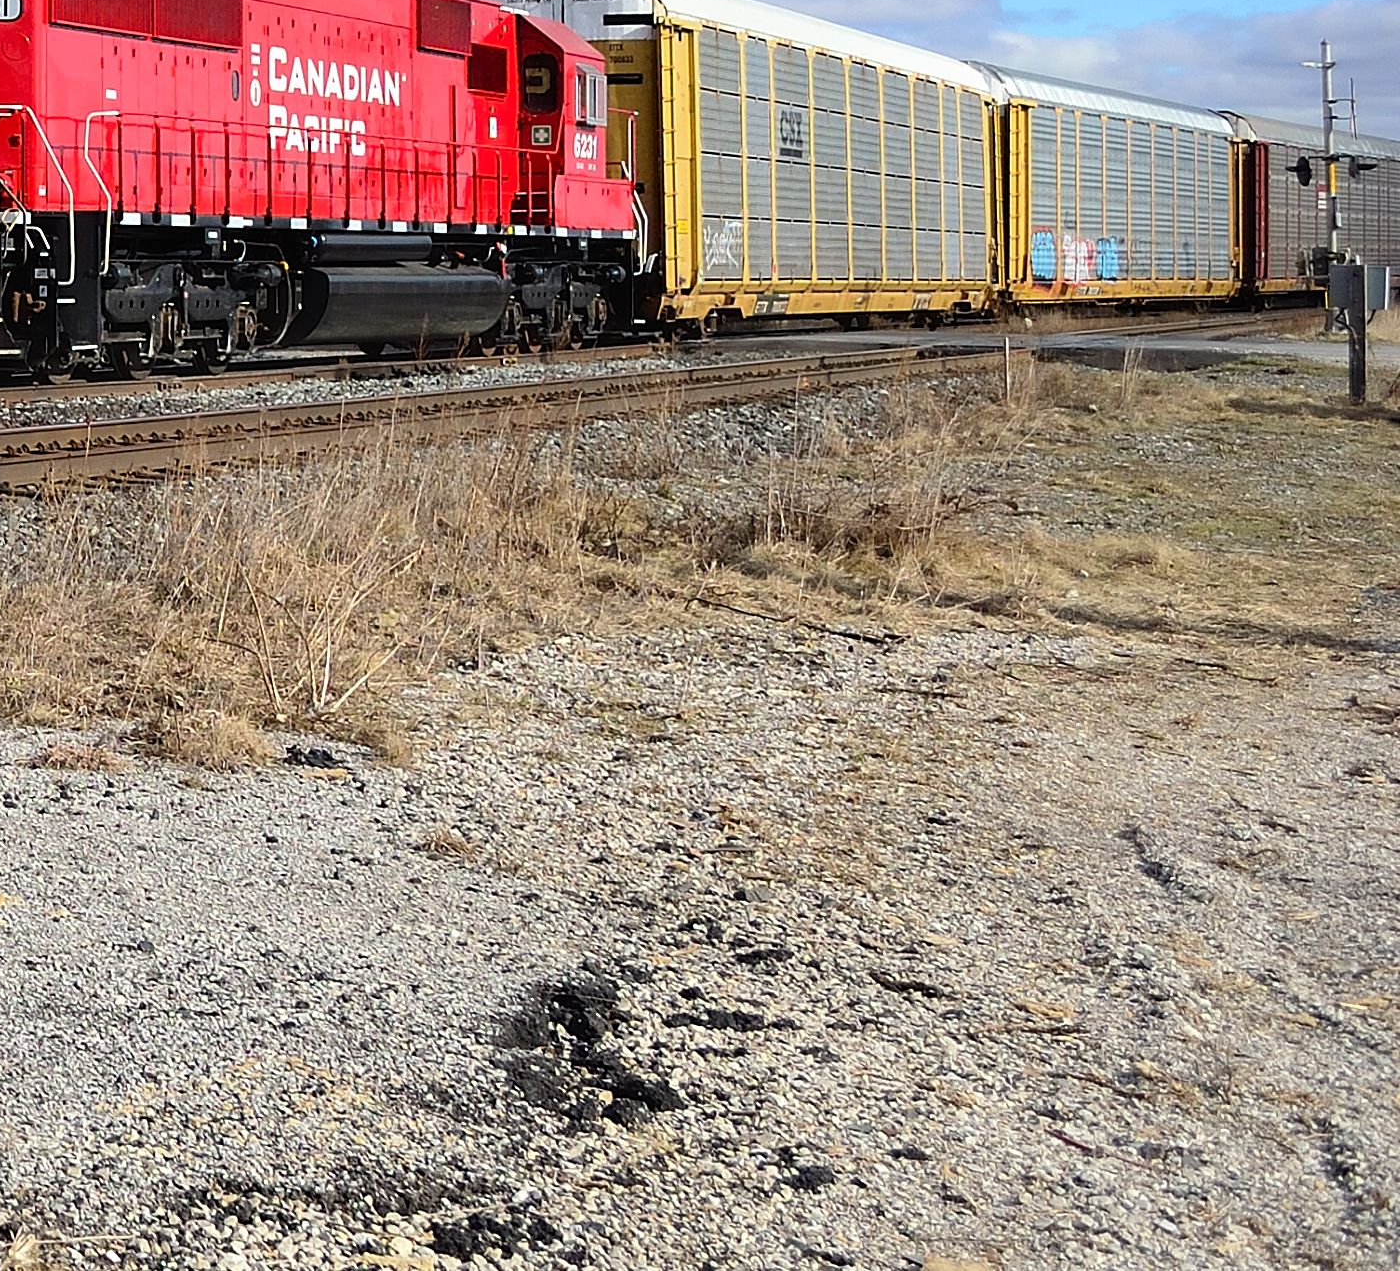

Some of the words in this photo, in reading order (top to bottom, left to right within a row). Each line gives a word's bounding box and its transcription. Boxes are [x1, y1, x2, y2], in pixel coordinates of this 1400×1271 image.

[269, 46, 400, 107] CANADIAN
[573, 132, 598, 160] 6231
[780, 108, 803, 148] CSX
